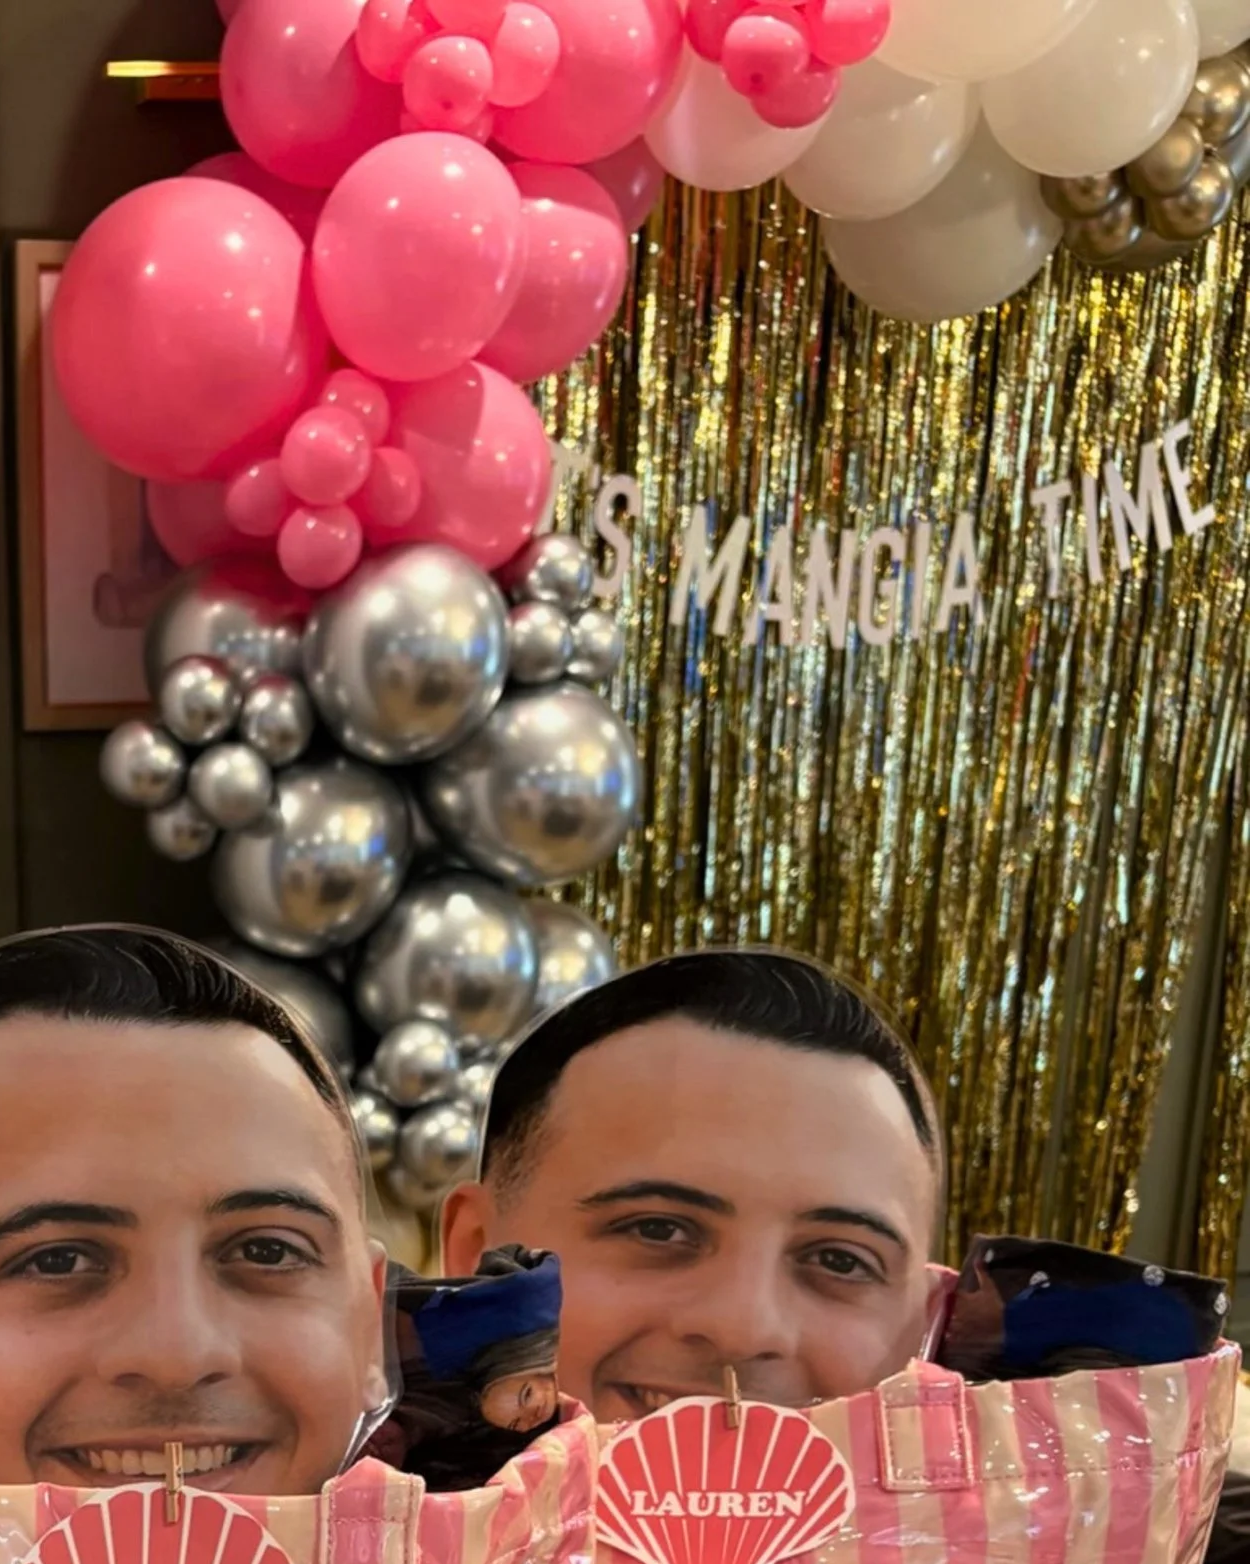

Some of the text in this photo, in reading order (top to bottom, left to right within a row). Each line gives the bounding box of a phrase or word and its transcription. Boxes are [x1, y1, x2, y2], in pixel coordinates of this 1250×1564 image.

[672, 505, 985, 649] MANGIA
[1031, 420, 1215, 598] TIME
[631, 1490, 806, 1517] LAUREN
